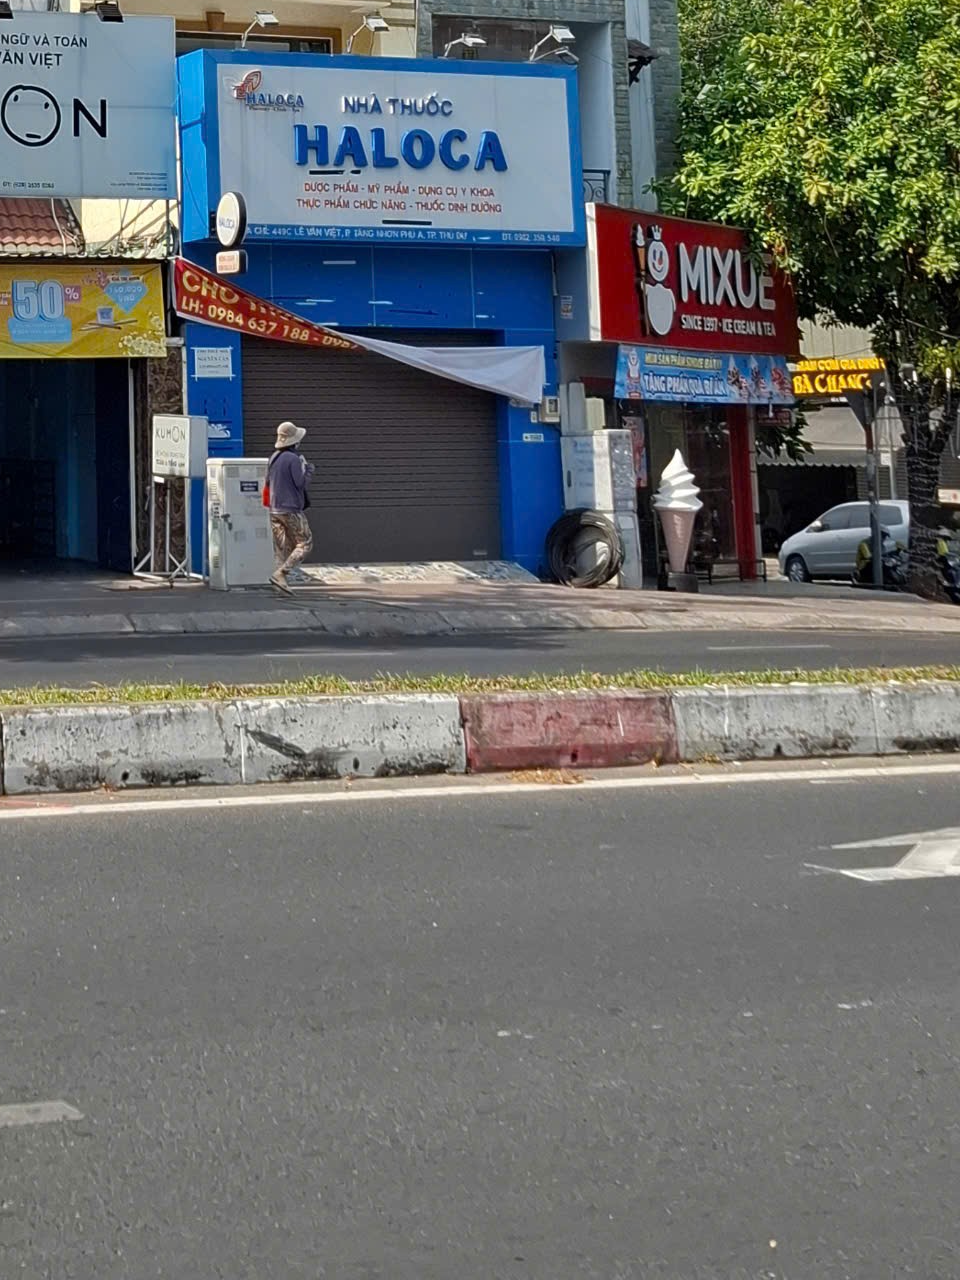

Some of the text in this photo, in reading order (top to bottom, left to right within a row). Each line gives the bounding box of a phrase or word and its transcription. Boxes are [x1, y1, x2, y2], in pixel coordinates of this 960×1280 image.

[1, 32, 30, 46] NGỮ
[33, 33, 50, 47] VÀ
[54, 33, 88, 48] TOÁN
[28, 52, 63, 69] VIỆT
[245, 92, 304, 107] HALOCA
[342, 91, 453, 117] NHÀ THUỐC
[294, 124, 508, 171] HALOCA
[304, 181, 494, 197] DƯỢC PHẨM MỸ PHẨM DỤNG CỤ Y KHOA
[296, 197, 321, 209] THỰC
[324, 196, 350, 209] PHẨM
[353, 197, 378, 210] CHỨC
[381, 199, 406, 211] NĂNG
[415, 200, 445, 212] THUỐC
[294, 226, 305, 236] LÊ
[307, 227, 322, 237] VĂN
[679, 242, 776, 310] MIXUE
[182, 270, 240, 304] CHO
[182, 296, 204, 315] LH:
[208, 305, 245, 327] 0984
[247, 318, 277, 334] 637
[283, 325, 310, 342] 188
[681, 314, 702, 330] SINCE
[703, 316, 718, 332] 1997
[722, 318, 733, 333] ICE
[733, 319, 756, 335] CREAM
[763, 322, 776, 336] TEA
[643, 370, 667, 395] TẶNG
[155, 425, 186, 443] KUMON
